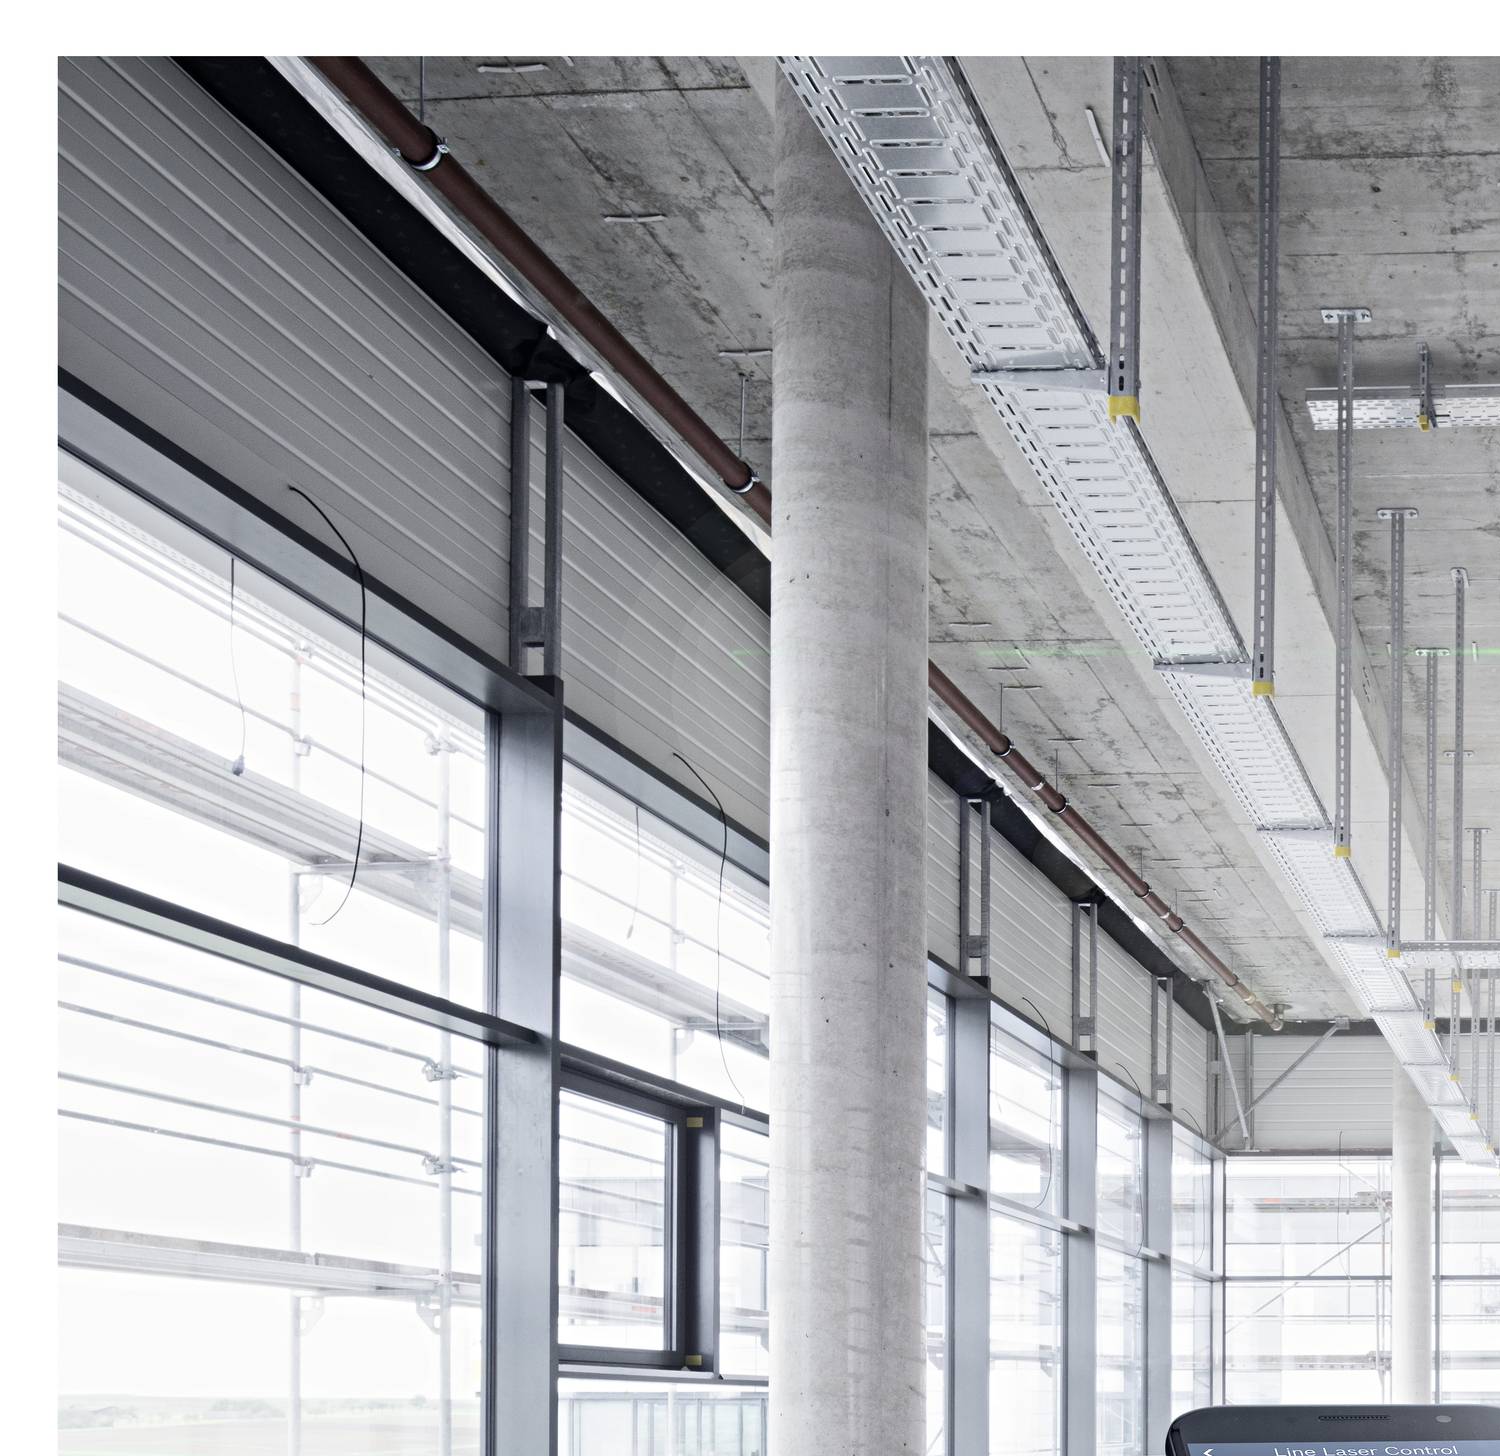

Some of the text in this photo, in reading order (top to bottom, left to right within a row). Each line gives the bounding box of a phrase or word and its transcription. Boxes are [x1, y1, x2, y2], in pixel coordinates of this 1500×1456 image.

[1274, 1445, 1459, 1456] Line Laser Control
